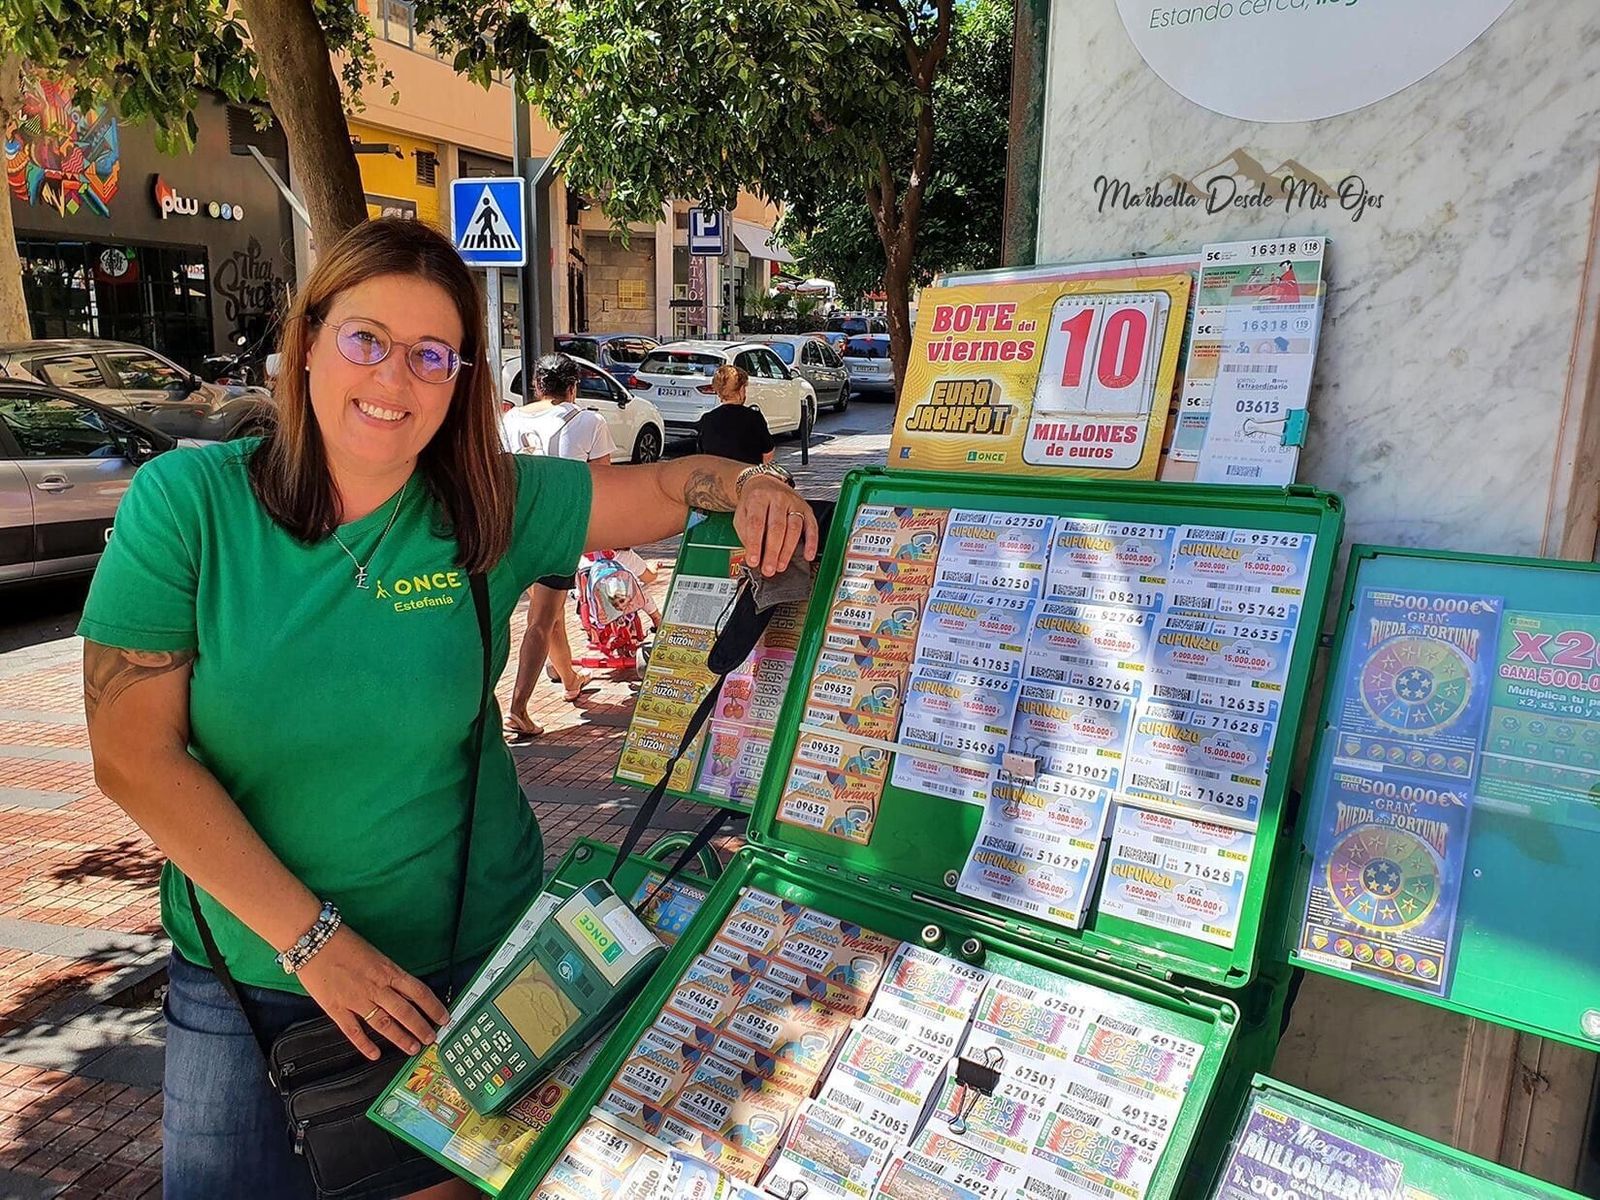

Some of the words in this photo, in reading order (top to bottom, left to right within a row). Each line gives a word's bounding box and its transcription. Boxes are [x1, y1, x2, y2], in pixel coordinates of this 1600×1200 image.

[1150, 0, 1233, 29] Estando
[696, 212, 716, 236] P
[1206, 251, 1220, 261] 5€
[1250, 243, 1297, 255] 16318
[932, 303, 1016, 334] BOTE
[1018, 320, 1036, 332] del
[1242, 320, 1288, 331] 16318
[1197, 325, 1212, 334] 5€
[927, 336, 1035, 362] viernes
[1060, 307, 1148, 389] 10
[930, 379, 993, 406] EURO
[1237, 382, 1289, 391] Extraordinario
[1187, 397, 1201, 406] 5€
[1236, 400, 1279, 413] 03613
[906, 404, 1012, 434] JACKPOT
[1033, 423, 1138, 444] MILLONES
[978, 452, 1004, 461] ONCE
[1045, 444, 1066, 457] de
[1069, 446, 1114, 460] euros
[1005, 513, 1044, 527] 62750
[864, 534, 892, 546] 10509
[1121, 526, 1164, 538] 08211
[1251, 534, 1298, 547] 95742
[1057, 534, 1114, 553] CUPONAZO
[1180, 543, 1239, 559] CUPONAZO
[394, 572, 462, 595] ONCE
[992, 576, 1030, 590] 62750
[1147, 576, 1166, 584] ONCE
[1109, 591, 1152, 606] 08211
[1280, 587, 1301, 595] ONCE
[394, 594, 454, 612] Estefanía
[986, 597, 1024, 609] 41783
[1238, 602, 1286, 618] 95742
[1394, 595, 1482, 615] 500.000€
[844, 608, 872, 620] 68481
[1035, 615, 1092, 634] CUPONAZO
[1232, 626, 1279, 641] 12635
[1159, 633, 1220, 651] CUPONAZO
[1367, 617, 1407, 650] RUEDA
[1422, 624, 1480, 663] FORTUNA
[1507, 630, 1600, 669] x2
[972, 656, 1010, 671] 41783
[1499, 664, 1537, 681] GANA
[823, 683, 852, 696] 09632
[970, 675, 1008, 690] 35496
[1087, 676, 1130, 692] 82764
[1259, 682, 1281, 690] ONCE
[1077, 695, 1120, 710] 21907
[1508, 685, 1567, 702] Multiplica
[1572, 694, 1584, 704] tu
[1219, 695, 1265, 713] 12635
[1519, 699, 1537, 708] x2,
[1540, 702, 1557, 711] x5,
[1560, 705, 1581, 714] x10
[1212, 716, 1259, 734] 71628
[811, 742, 840, 755] 09632
[956, 738, 995, 754] 35496
[1067, 762, 1108, 779] 21907
[1239, 777, 1260, 786] ONCE
[1053, 783, 1096, 799] 51679
[1197, 788, 1244, 807] 71628
[1360, 778, 1450, 807] 500.000€
[796, 801, 826, 816] 09632
[1375, 799, 1414, 815] GRAN
[1333, 800, 1374, 837] RUEDA
[1390, 814, 1448, 860] FORTUNA
[972, 852, 1025, 875] CUPONAZO
[1036, 850, 1079, 868] 51679
[1111, 863, 1173, 889] CUPONAZO
[1184, 861, 1230, 882] 71628
[578, 914, 608, 947] ONCE
[740, 920, 770, 939] 46878
[796, 942, 829, 960] 92027
[949, 963, 986, 982] 18650
[688, 990, 720, 1010] 94643
[1044, 997, 1085, 1017] 67501
[746, 1014, 780, 1034] 89549
[918, 1026, 954, 1048] 18650
[904, 1043, 943, 1065] 57083
[635, 1066, 669, 1088] 23541
[1015, 1066, 1056, 1089] 67501
[1003, 1084, 1046, 1107] 27014
[693, 1093, 729, 1117] 24184
[870, 1109, 909, 1134] 57083
[595, 1130, 630, 1154] 23541
[850, 1126, 888, 1150] 29840
[1111, 1127, 1158, 1151] 81465
[954, 1173, 998, 1198] 54921
